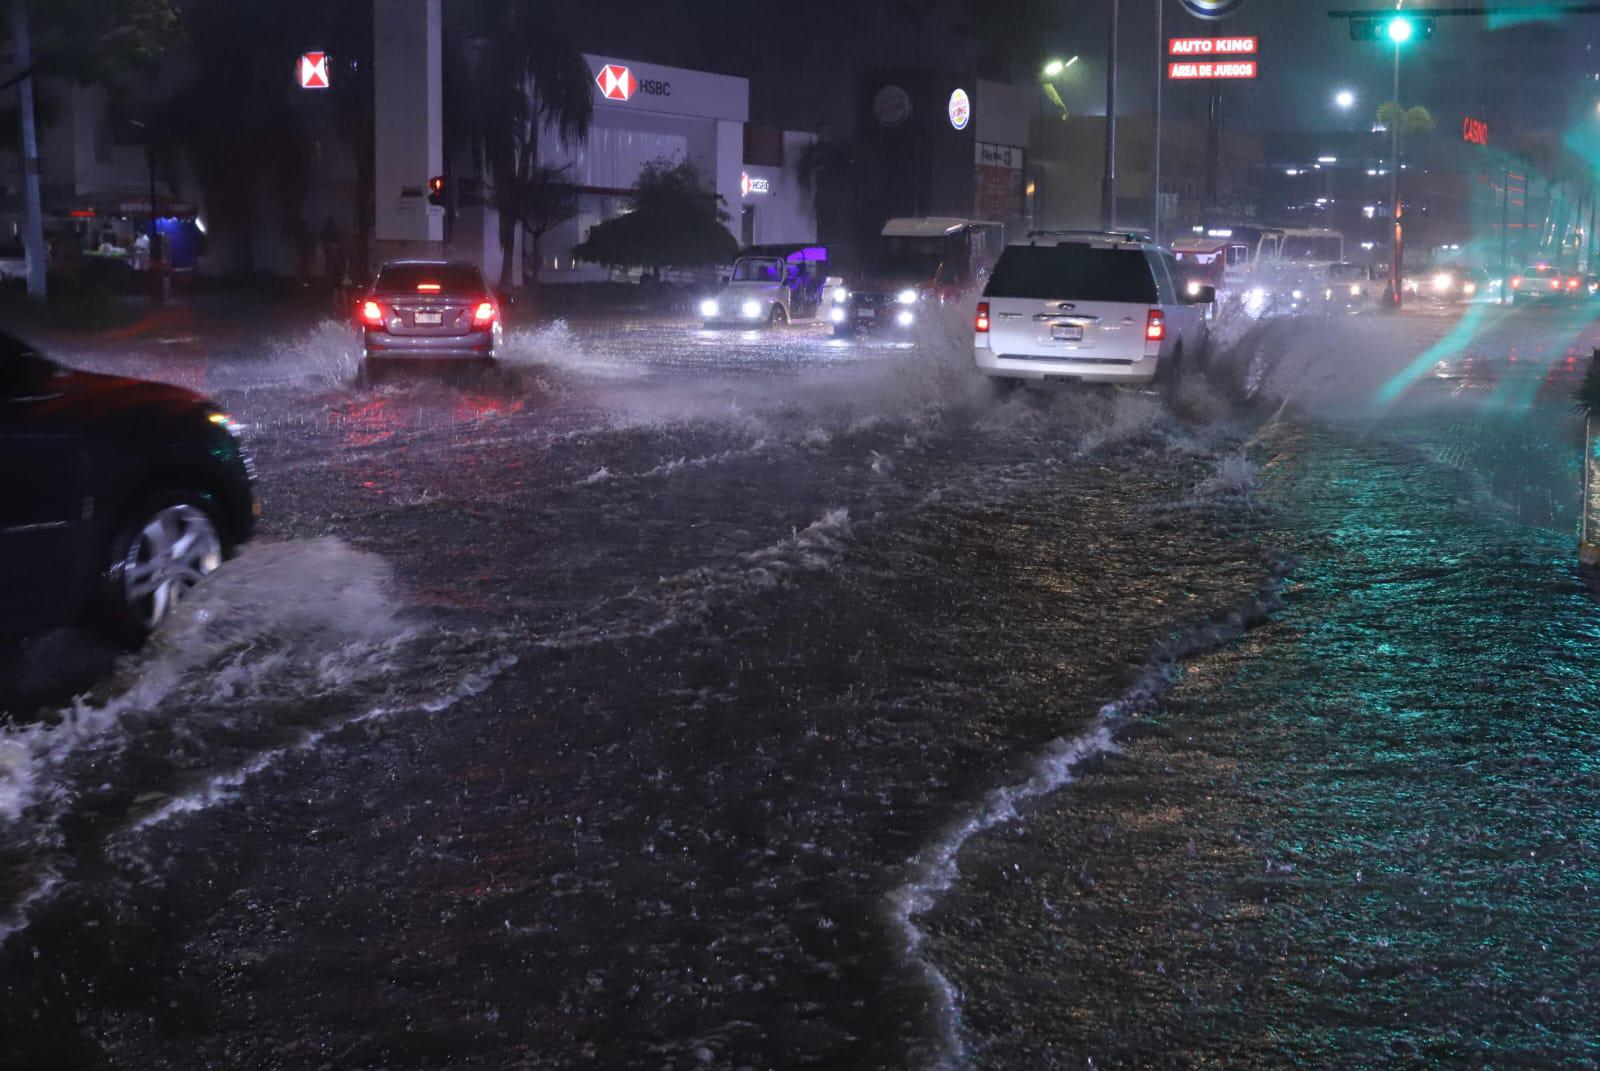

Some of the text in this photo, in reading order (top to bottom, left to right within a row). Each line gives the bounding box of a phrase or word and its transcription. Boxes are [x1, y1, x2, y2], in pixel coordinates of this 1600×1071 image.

[1172, 39, 1254, 53] AUTO KING
[1199, 64, 1212, 76] DE
[1213, 63, 1253, 77] JUEGOS
[640, 79, 671, 96] HSBC
[1463, 116, 1489, 145] CASINO
